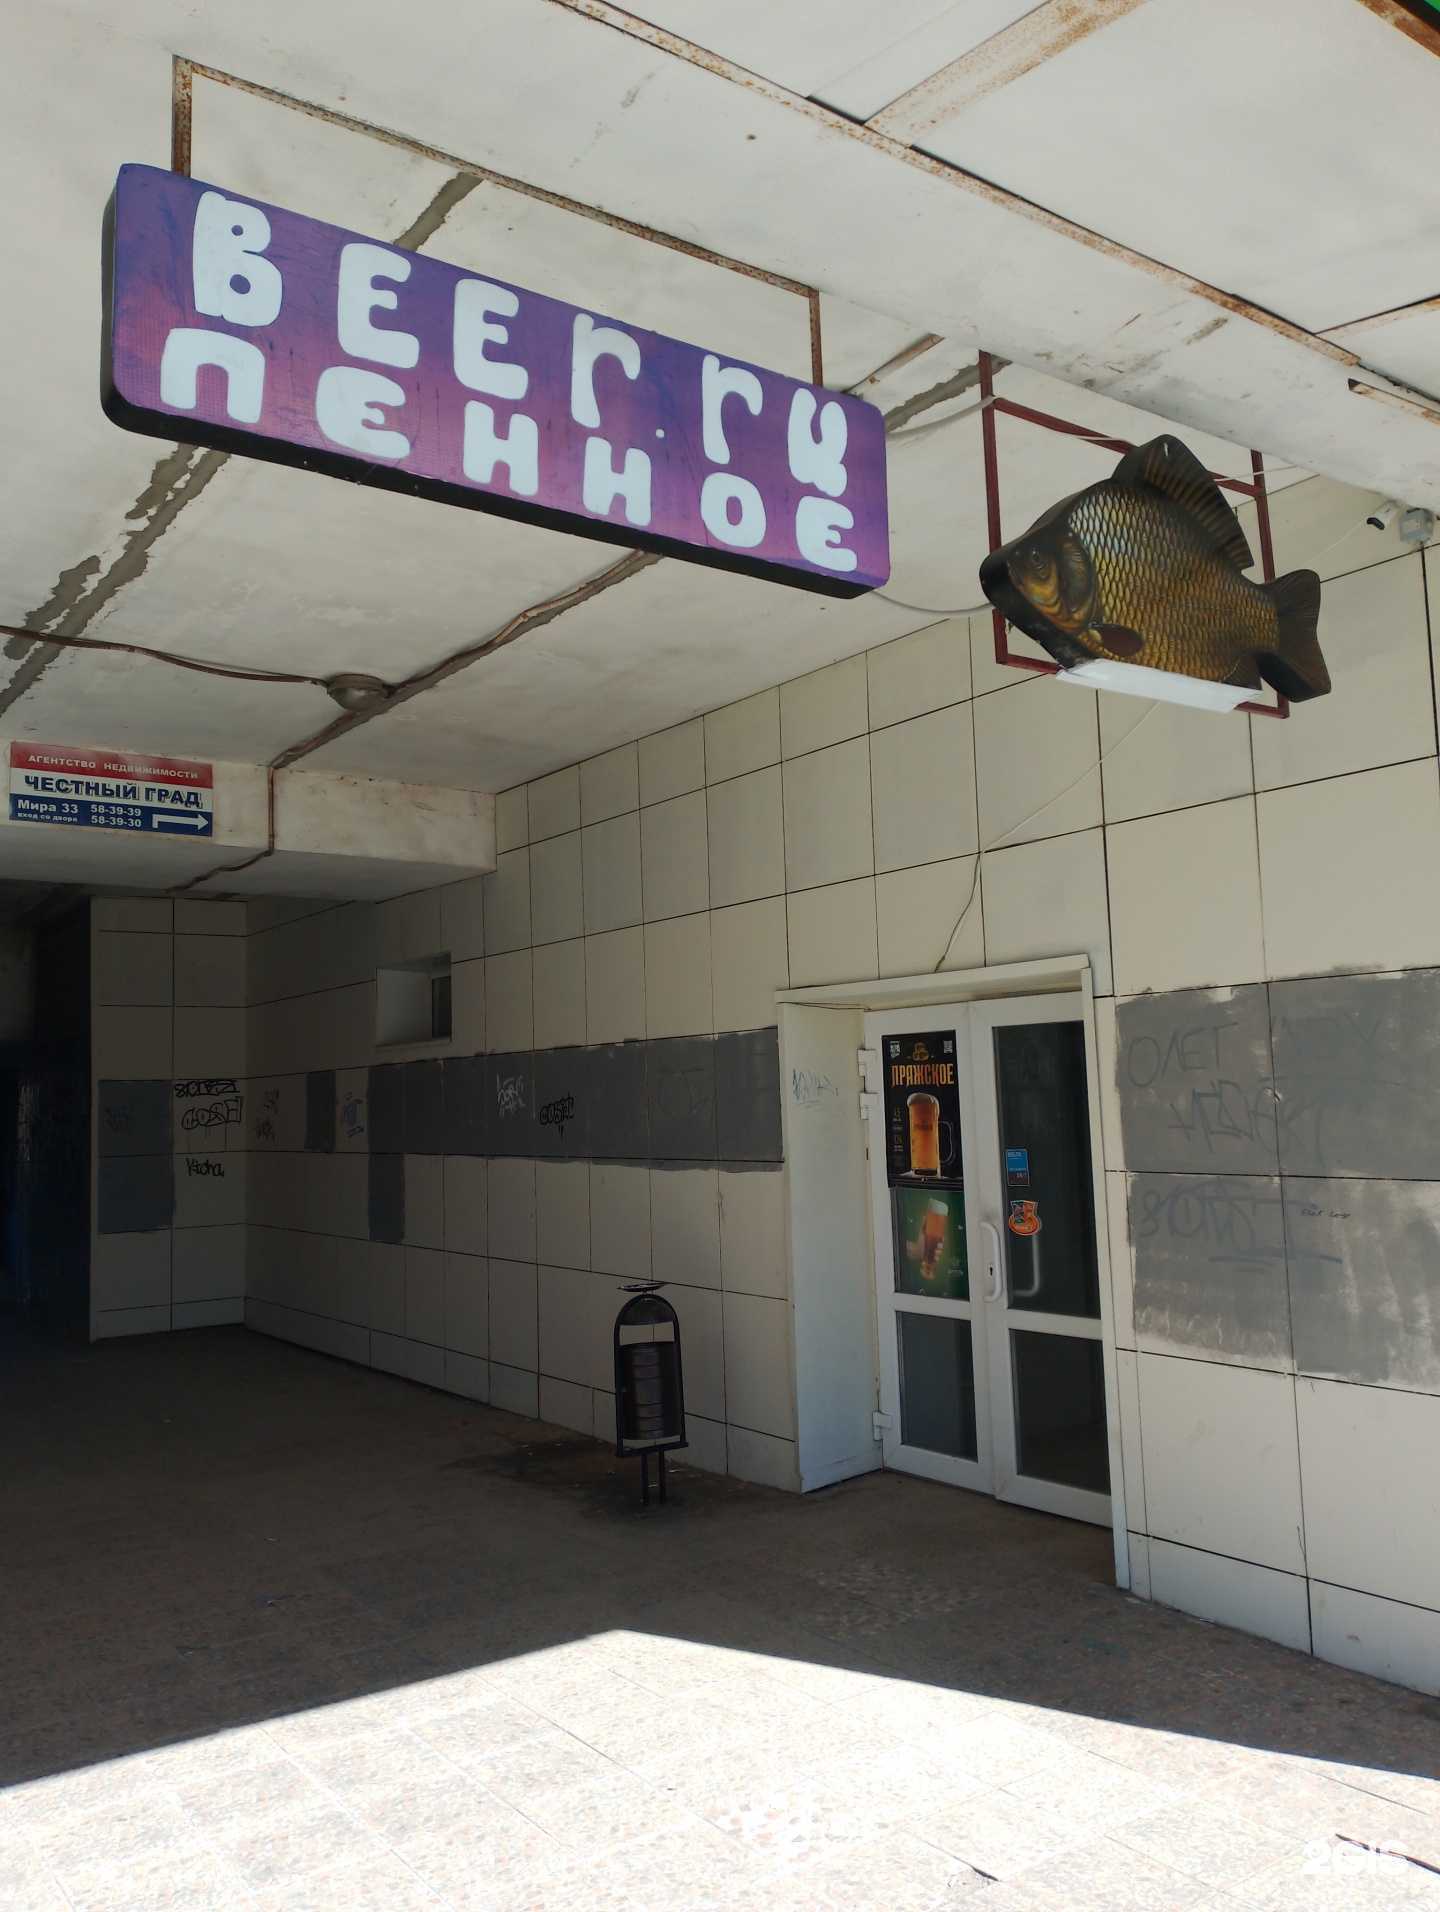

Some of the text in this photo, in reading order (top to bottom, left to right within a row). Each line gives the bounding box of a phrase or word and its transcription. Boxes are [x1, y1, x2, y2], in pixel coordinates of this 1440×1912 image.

[160, 328, 858, 572] ПЕННОЕ
[28, 754, 199, 780] АГЕНТСТВО НЕДВИЖИМОСТИ
[24, 775, 204, 809] ЧЕСТНЫЙ ГРАД
[17, 798, 79, 814] Мира 33
[90, 804, 142, 817] 58-39-39
[90, 814, 143, 828] 58-39-30
[890, 1063, 955, 1088] ПРАЖСКОЕ
